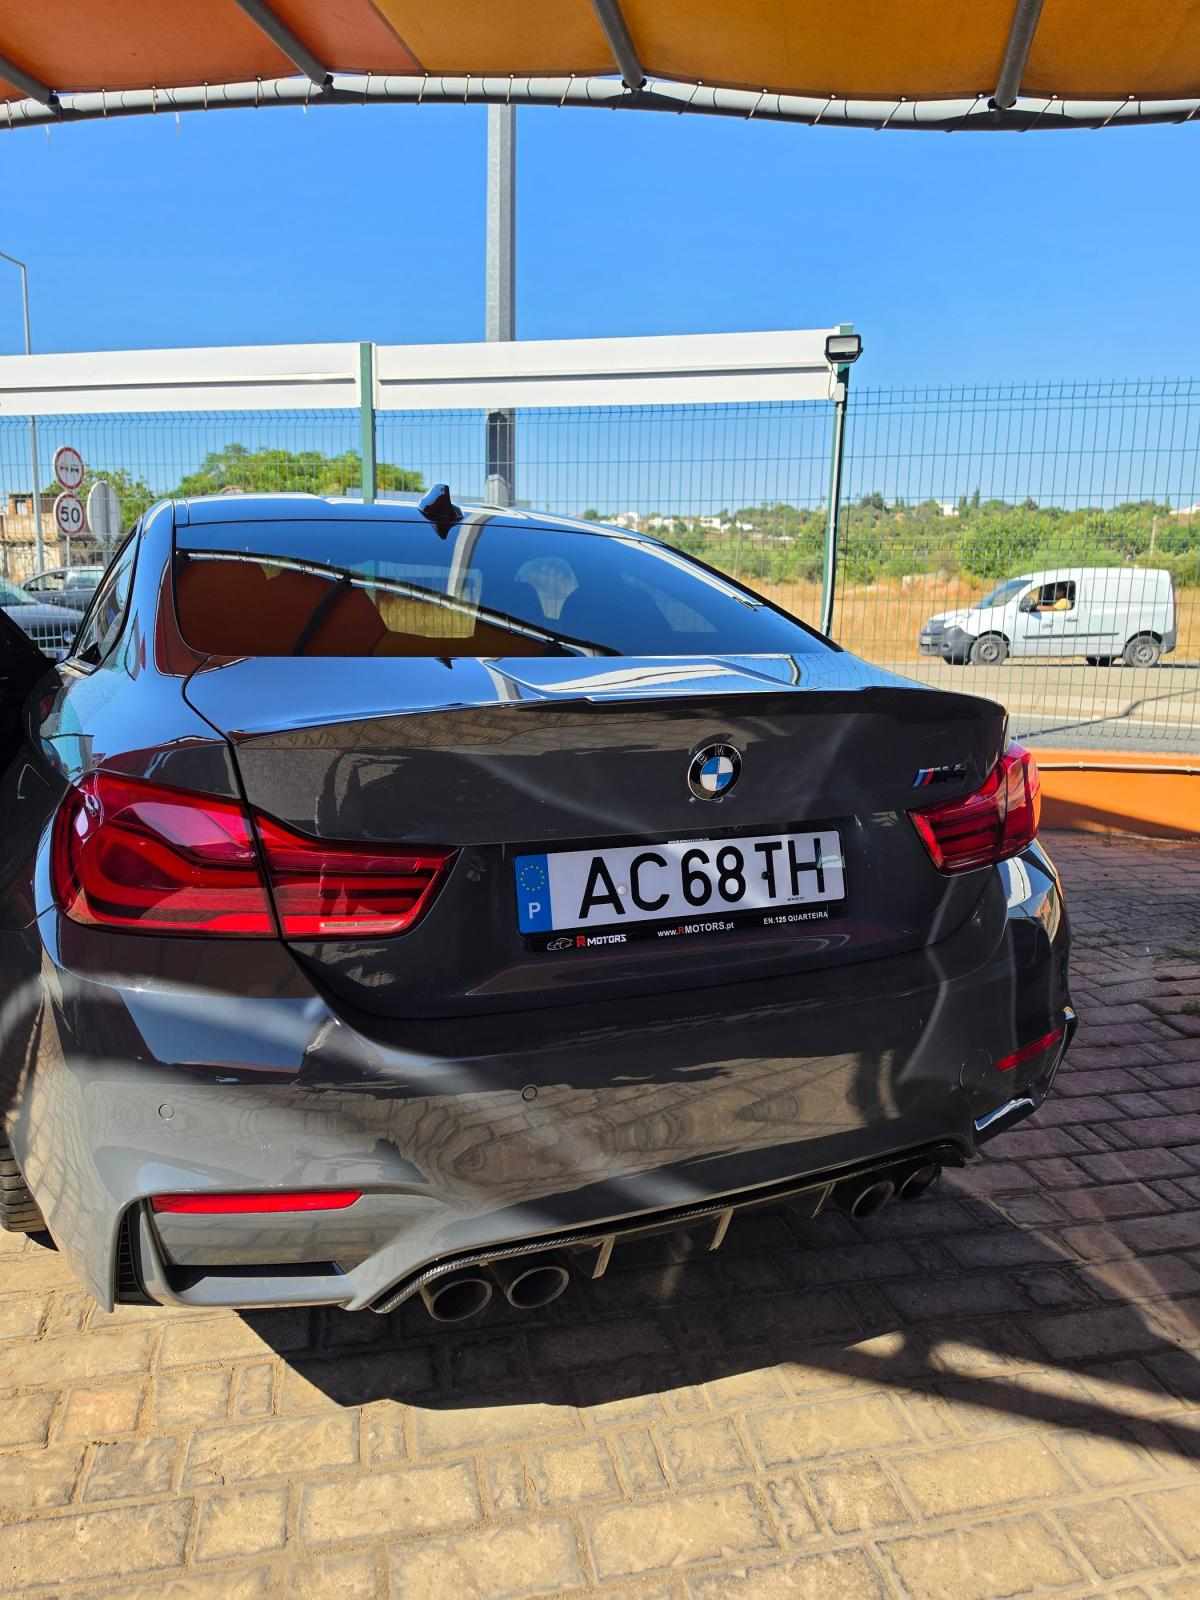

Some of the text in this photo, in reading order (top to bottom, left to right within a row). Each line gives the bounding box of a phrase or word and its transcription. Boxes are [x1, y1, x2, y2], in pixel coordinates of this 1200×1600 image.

[61, 506, 81, 524] 50
[528, 902, 541, 920] P
[788, 911, 829, 922] QUARTEIRA
[657, 922, 735, 938] www.RMOTORS.pt
